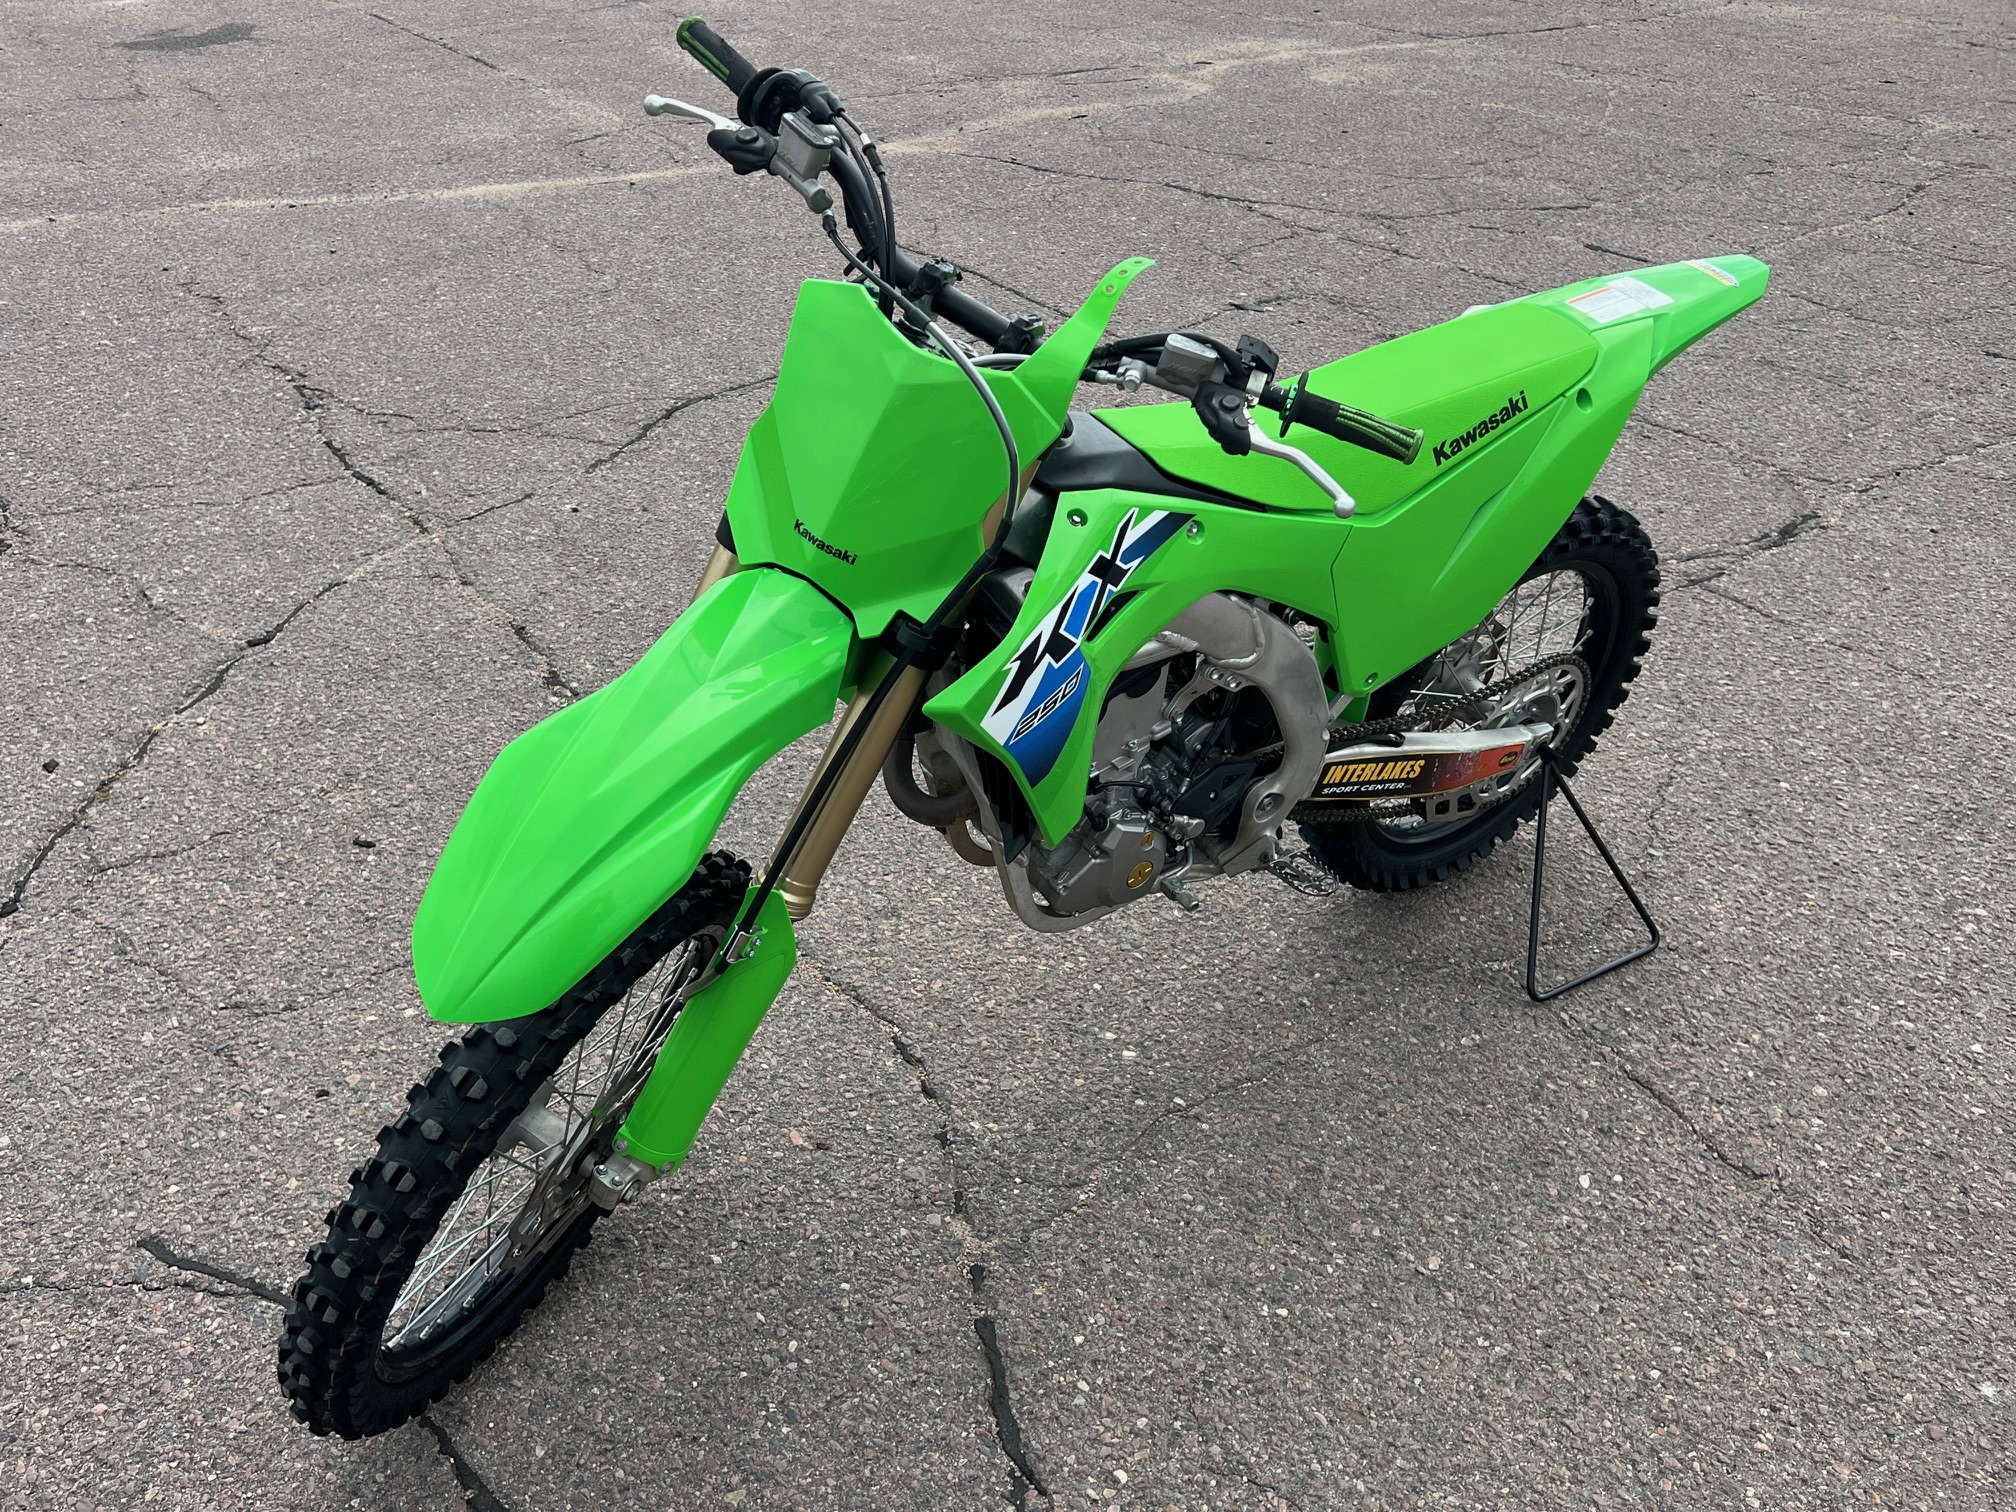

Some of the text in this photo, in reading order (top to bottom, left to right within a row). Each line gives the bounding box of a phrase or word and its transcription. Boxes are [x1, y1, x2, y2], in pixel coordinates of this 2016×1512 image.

[1432, 389, 1529, 467] Kawasaki
[793, 518, 858, 566] Kawasaki
[1009, 662, 1085, 745] 250
[1321, 785, 1360, 795] SPORT
[1360, 782, 1405, 792] CENTER
[1322, 759, 1425, 785] INTERLAKES
